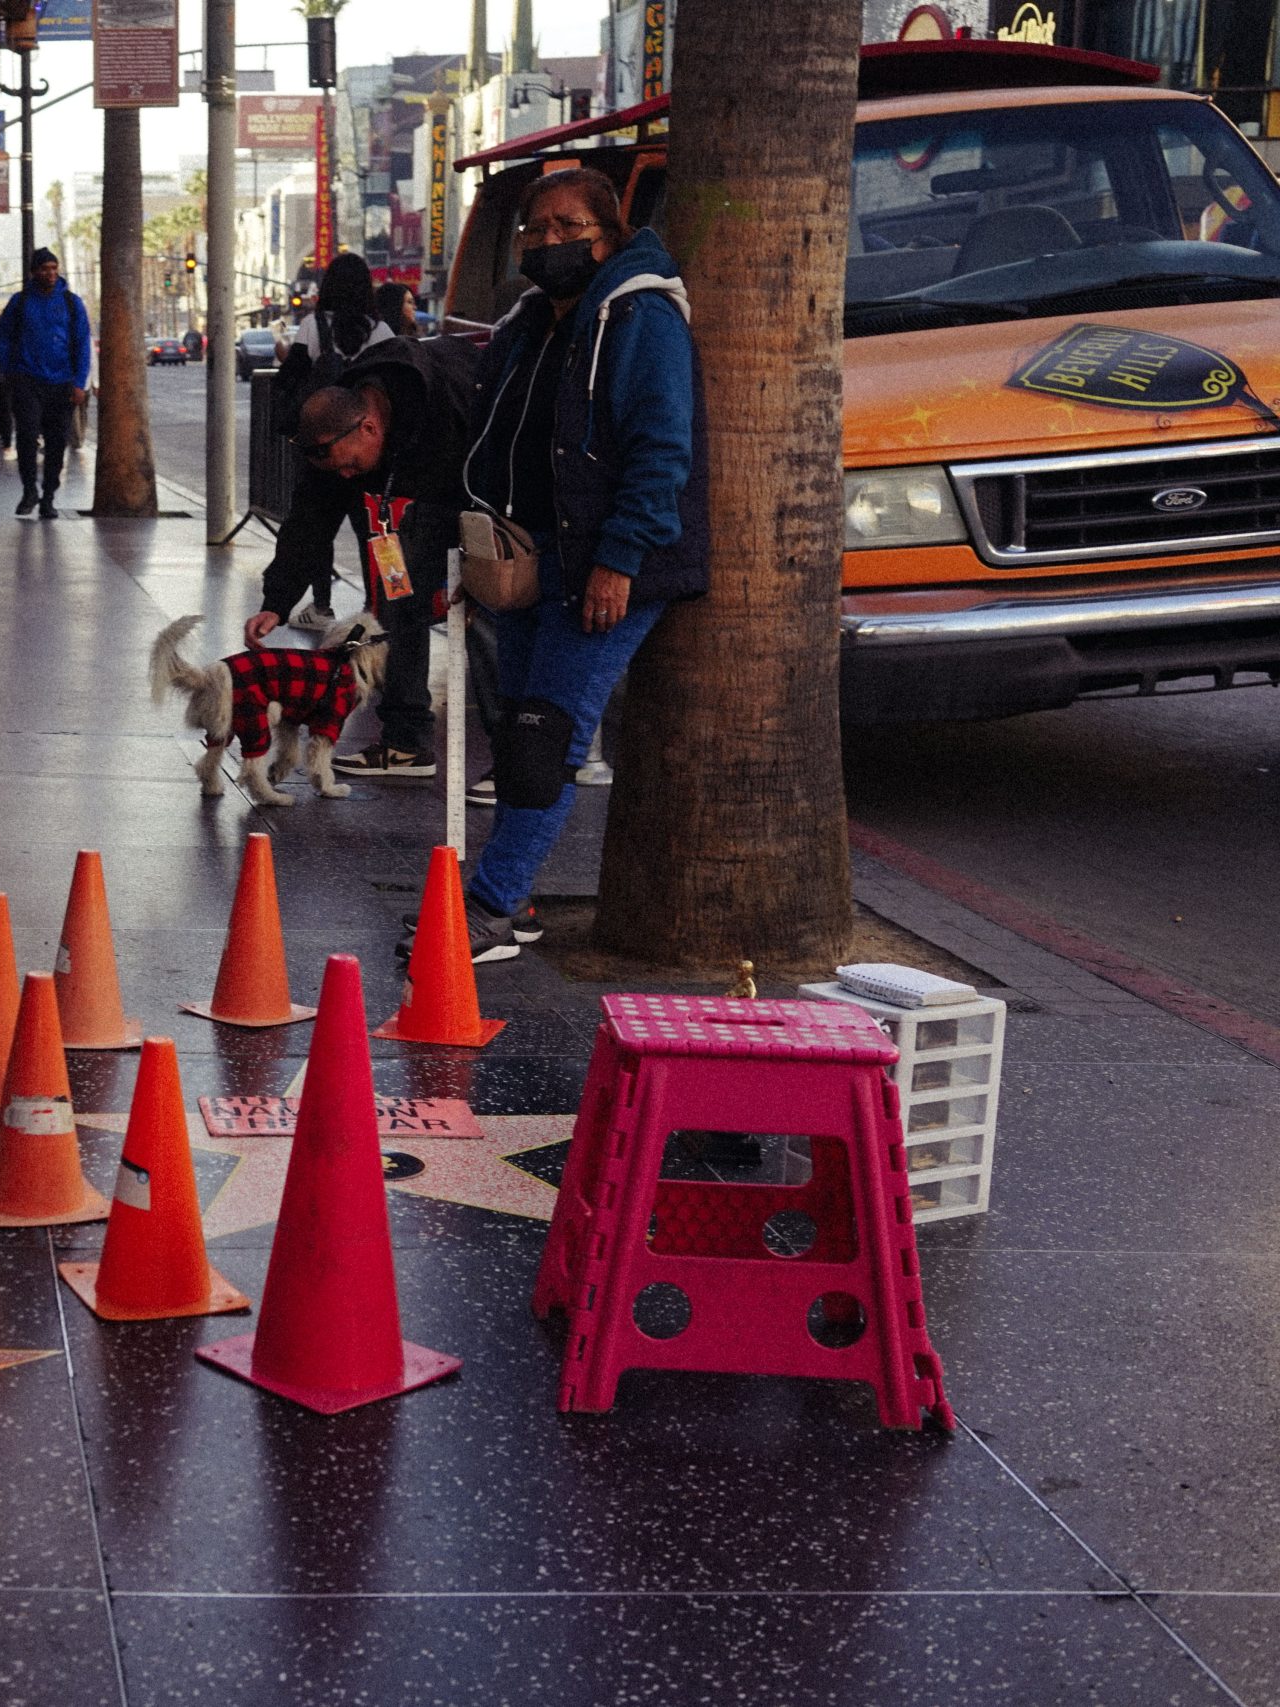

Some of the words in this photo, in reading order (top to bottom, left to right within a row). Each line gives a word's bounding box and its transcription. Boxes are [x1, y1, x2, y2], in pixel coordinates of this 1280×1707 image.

[431, 124, 446, 256] CHINESE
[320, 181, 329, 268] TUSSAUDS
[1044, 331, 1133, 387] BEVERLY
[1107, 343, 1179, 392] HILLS
[1165, 493, 1194, 505] Ford
[518, 713, 542, 725] HDX
[214, 1106, 298, 1117] NAM
[390, 1119, 451, 1131] AR
